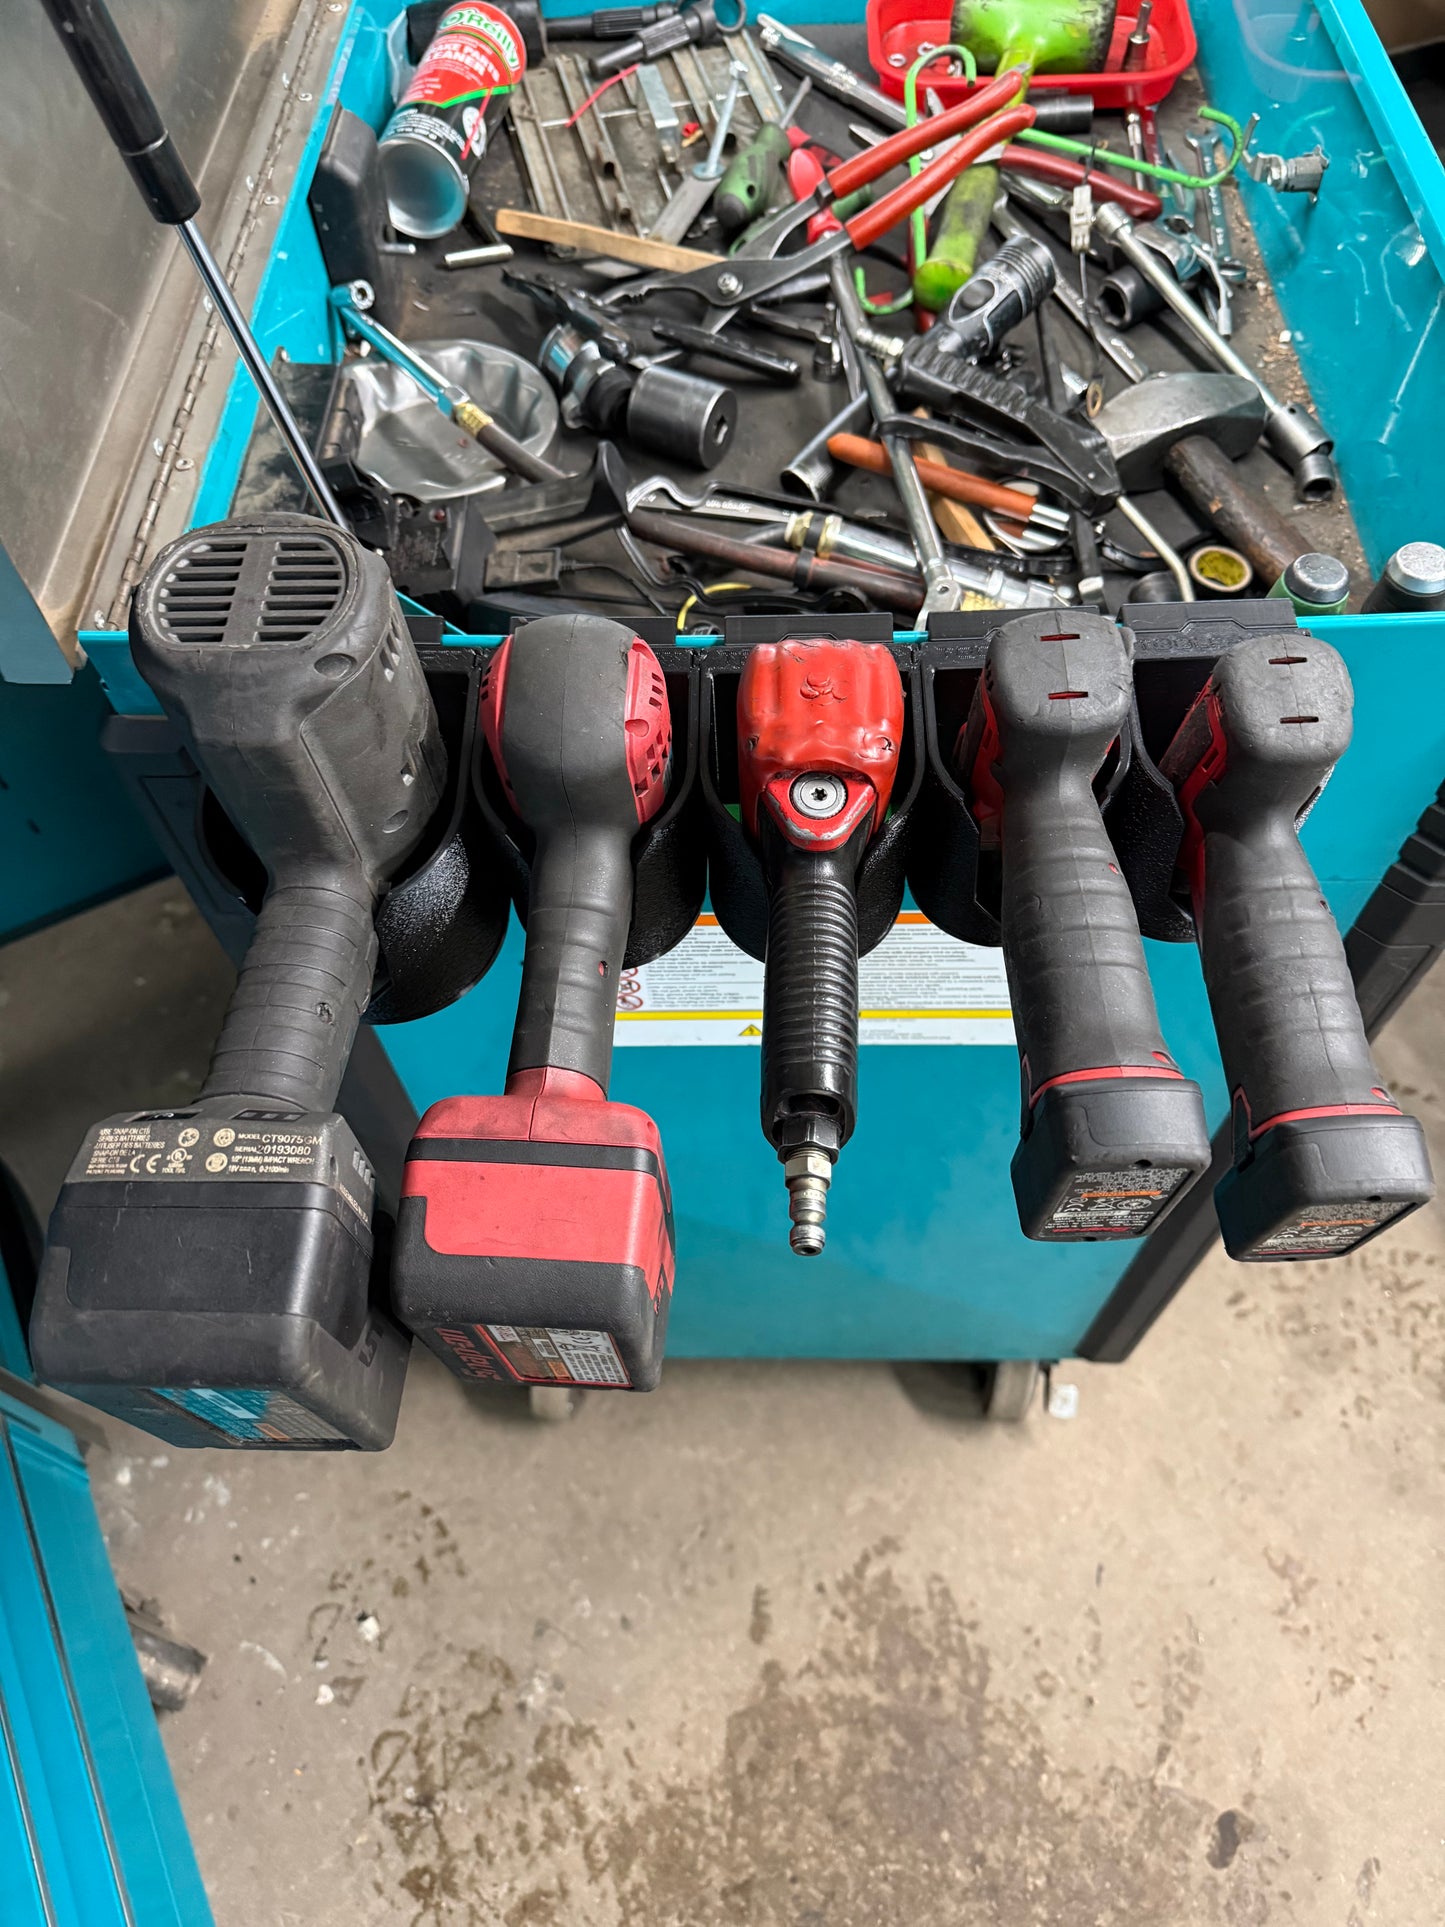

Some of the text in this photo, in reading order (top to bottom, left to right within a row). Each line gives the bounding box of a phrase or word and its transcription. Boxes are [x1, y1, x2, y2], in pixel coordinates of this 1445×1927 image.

[439, 8, 518, 66] O'Reilly
[463, 44, 501, 83] PARTS
[262, 1134, 323, 1146] CT9075GM
[257, 1145, 311, 1156] 20193080
[263, 1156, 286, 1164] IMPACT
[286, 1157, 316, 1165] WRENCH
